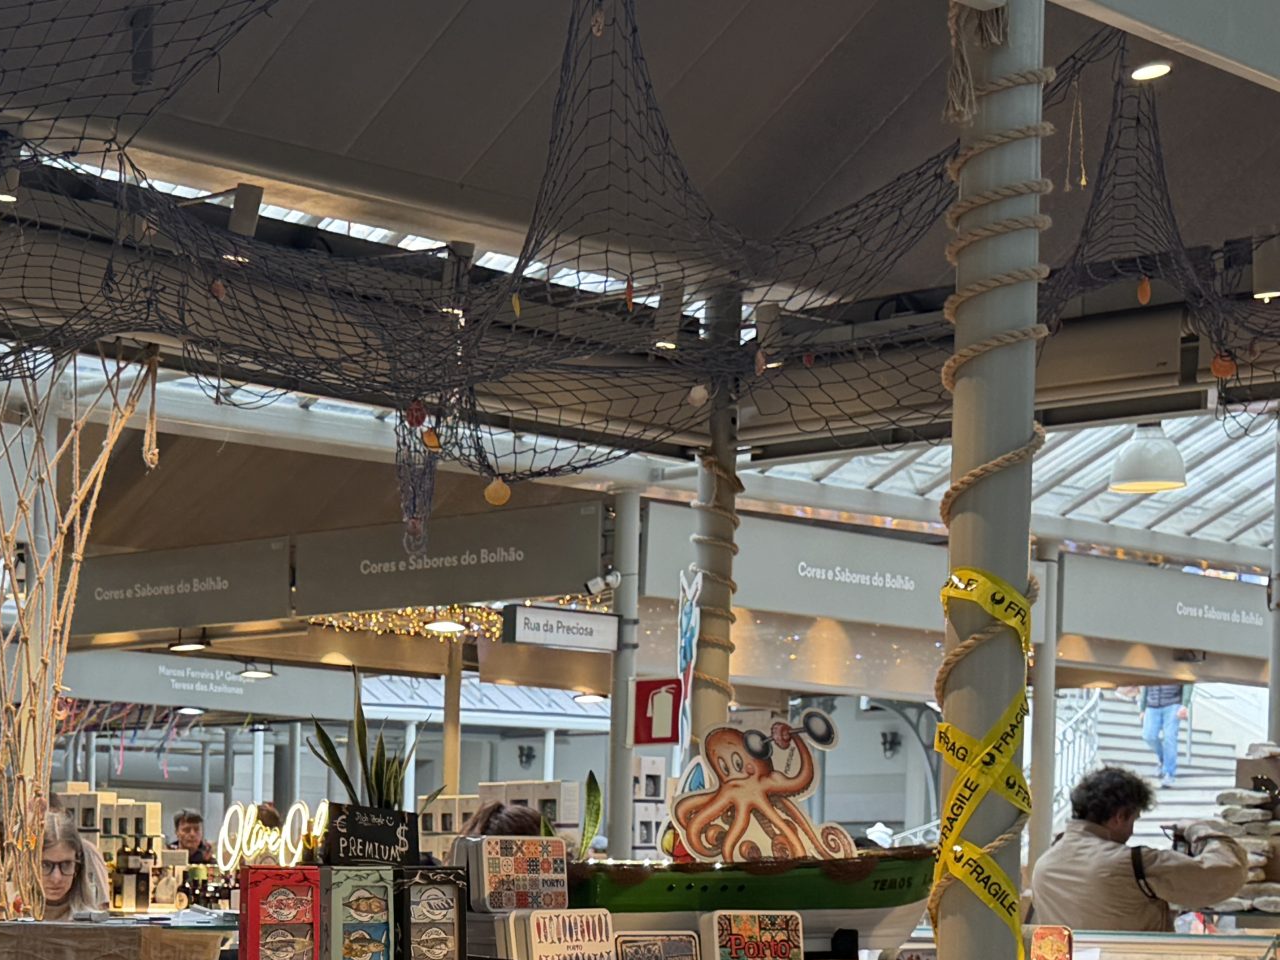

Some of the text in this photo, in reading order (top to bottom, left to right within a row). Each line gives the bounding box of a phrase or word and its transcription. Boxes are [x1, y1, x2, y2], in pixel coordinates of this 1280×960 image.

[360, 547, 524, 575] Cores e Sabores do Bolhão
[798, 561, 826, 580] Cores
[827, 569, 833, 580] e
[835, 566, 870, 585] Sabores
[872, 572, 884, 587] do
[94, 576, 229, 601] Cores e Sabores do Bolhão
[523, 617, 594, 637] Rua da Preciosa
[940, 777, 980, 841] FRAGILE
[217, 801, 281, 872] Olive
[339, 836, 401, 862] PREMIUM
[541, 878, 565, 888] PORTO
[872, 877, 913, 891] TEMOS
[962, 857, 1019, 918] FRAGILE
[729, 934, 791, 960] Porto
